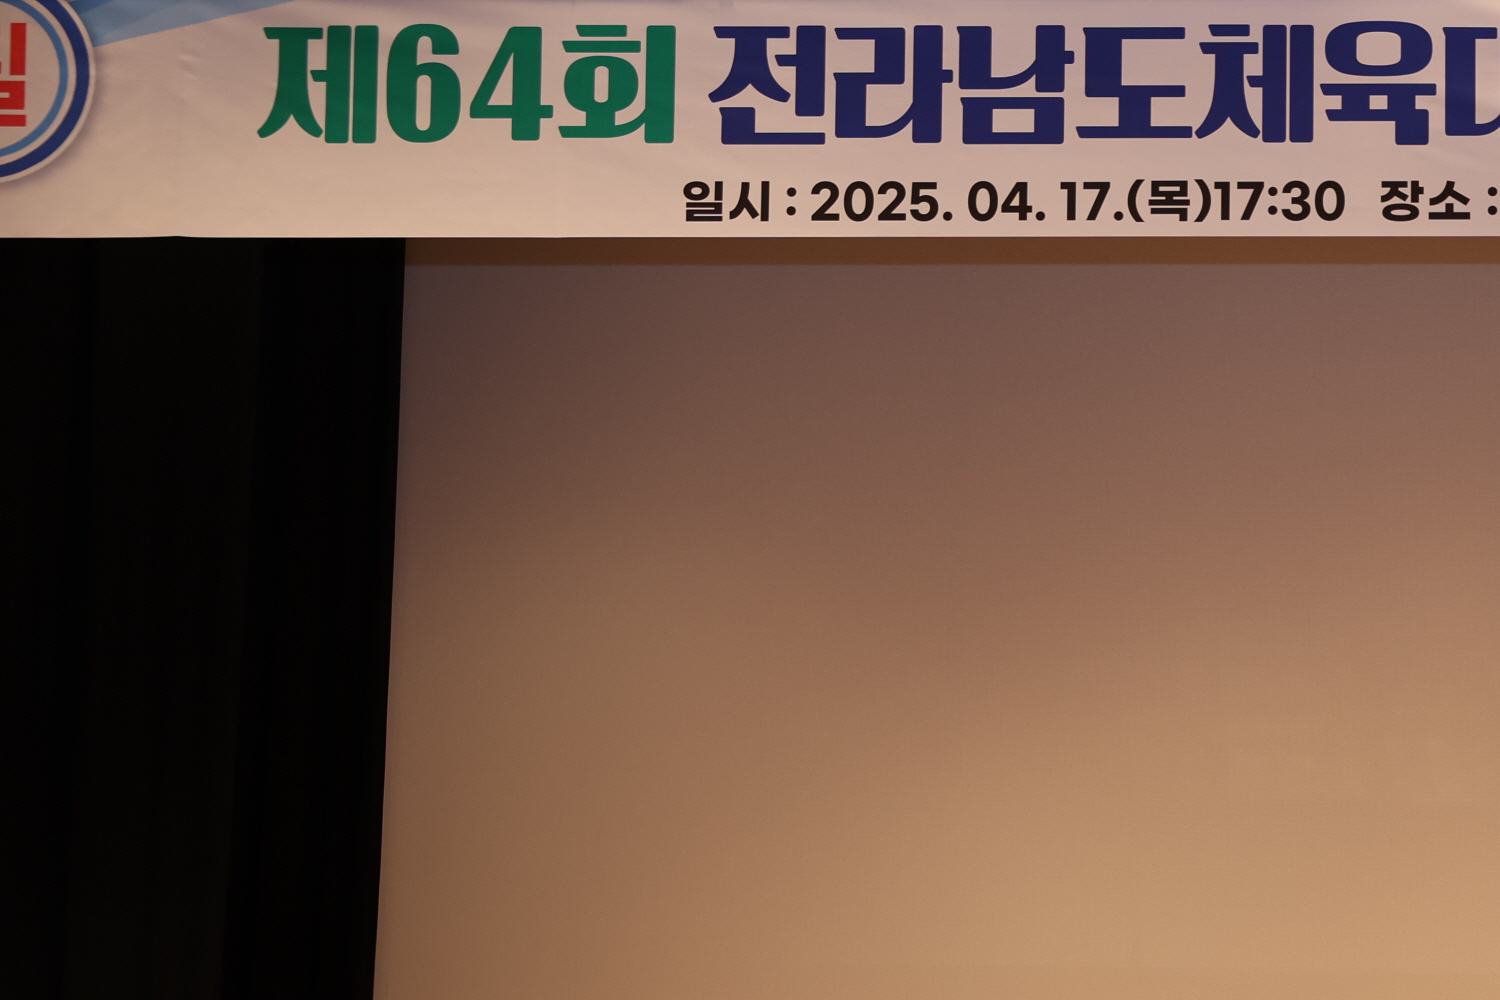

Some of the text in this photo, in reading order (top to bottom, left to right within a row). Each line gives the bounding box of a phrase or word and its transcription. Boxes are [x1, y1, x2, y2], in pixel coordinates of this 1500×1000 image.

[257, 23, 677, 144] 제64회
[810, 180, 953, 222] 2025.
[967, 180, 1046, 222] 04.
